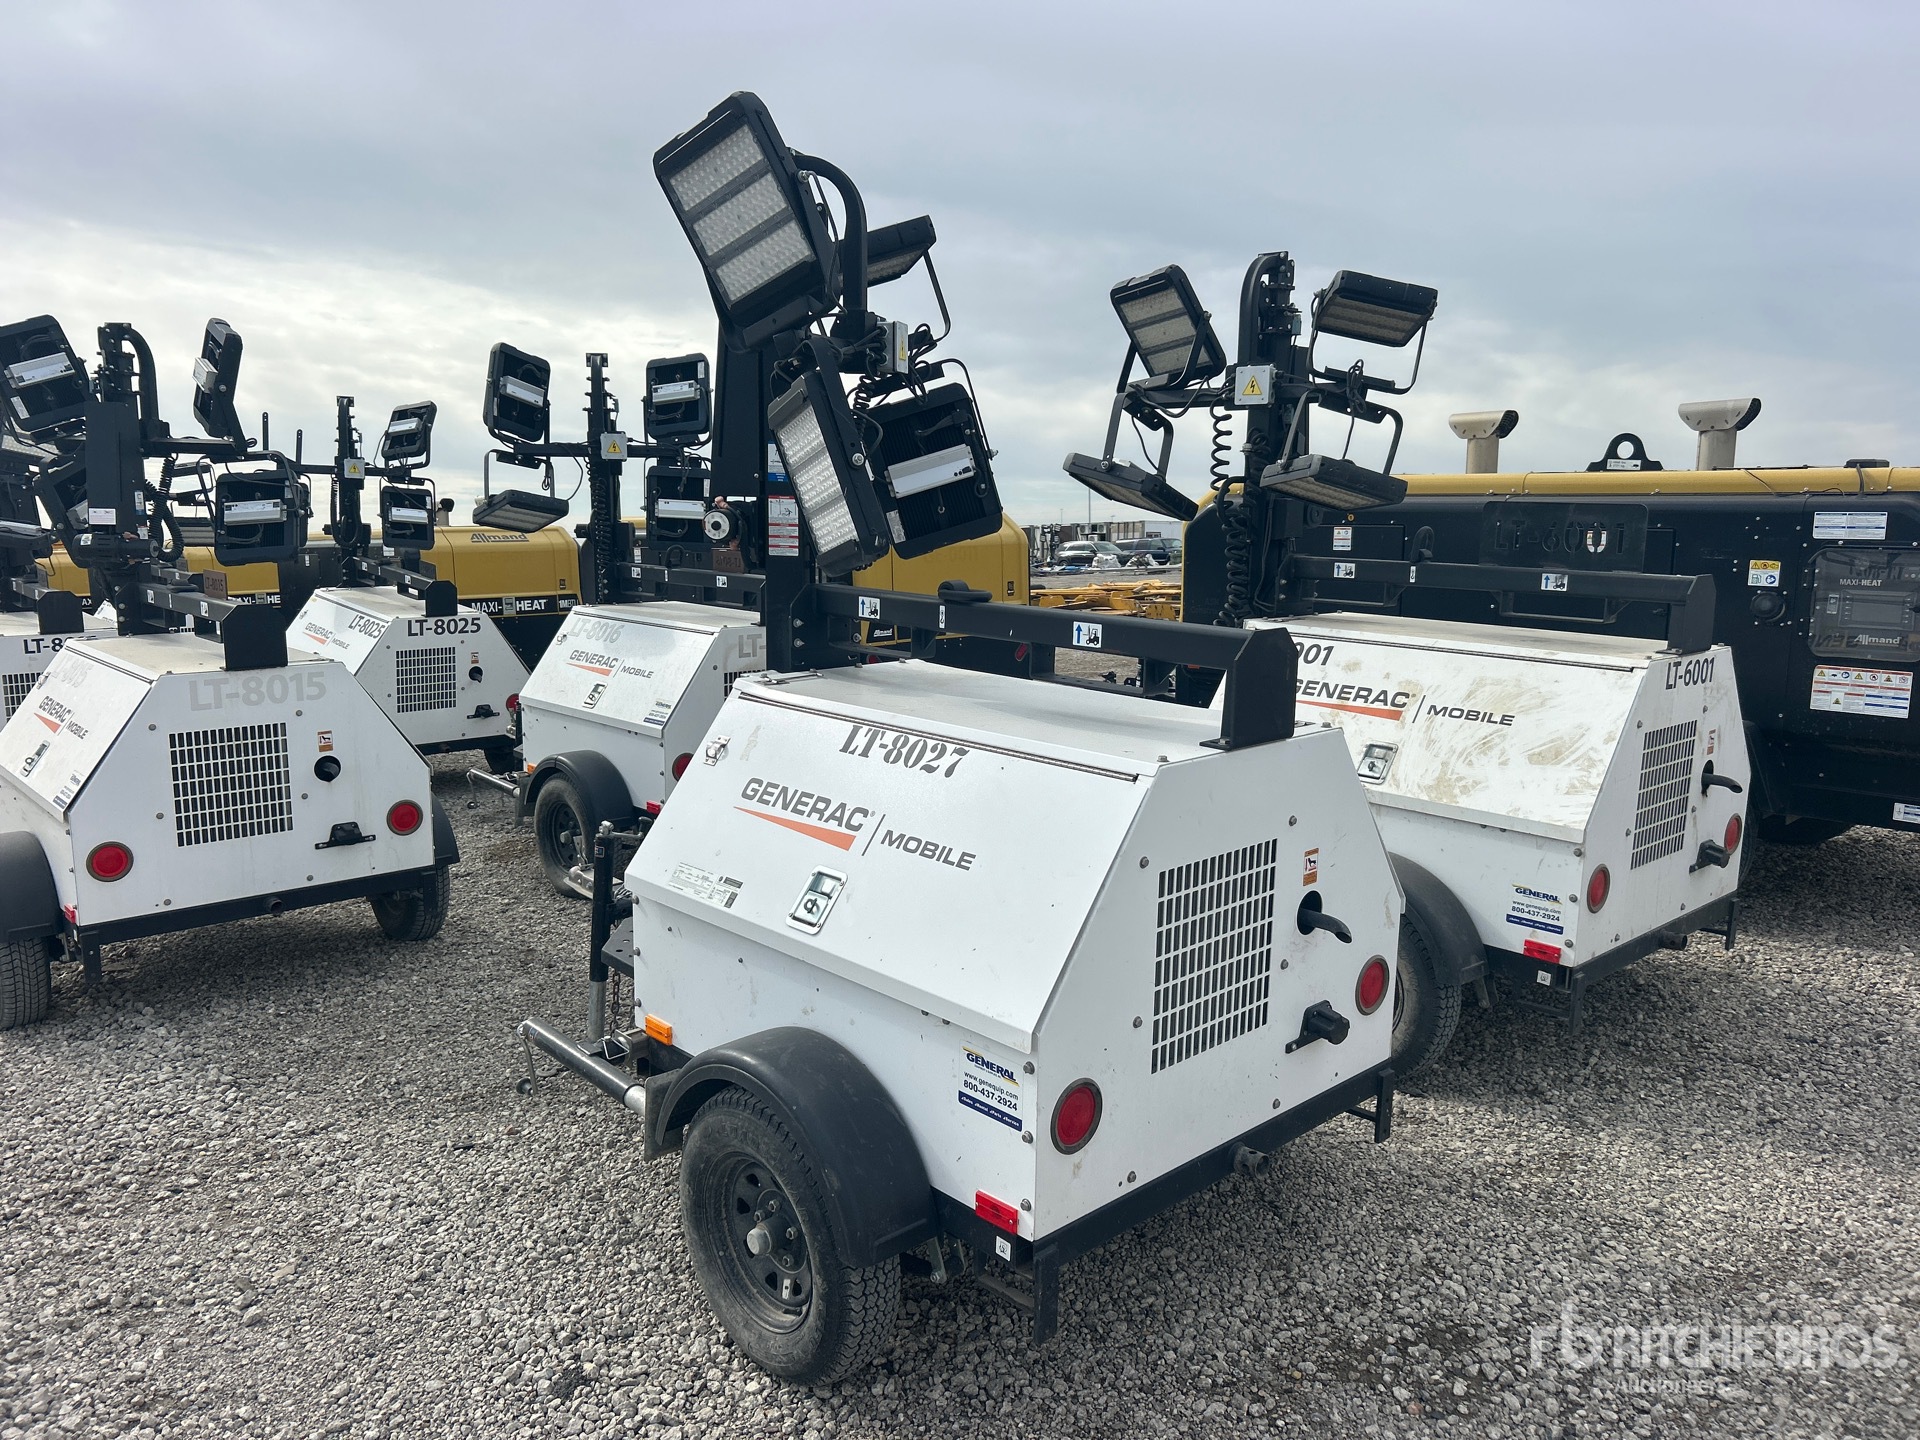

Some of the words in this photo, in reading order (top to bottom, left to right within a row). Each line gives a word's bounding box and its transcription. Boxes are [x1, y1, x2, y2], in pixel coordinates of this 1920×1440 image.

[470, 532, 529, 543] Allmand
[1494, 521, 1626, 554] LT-6001
[1839, 578, 1883, 587] MAXI-HEAT
[516, 599, 547, 611] HEAT
[304, 621, 333, 640] GENERAC
[331, 637, 351, 650] MOBILE
[348, 613, 386, 640] LT-8025
[407, 617, 482, 637] LT-8025
[569, 617, 626, 644] LT-8016
[1854, 633, 1902, 646] Allmand
[23, 636, 68, 655] LT-8
[738, 633, 767, 659] LT-
[569, 649, 620, 669] GENERAC
[620, 665, 655, 679] MOBILE
[1665, 657, 1715, 690] LT-6001
[188, 671, 328, 712] LT-8015
[38, 695, 72, 725] GENERAC
[66, 720, 90, 741] MOBILE
[1426, 704, 1516, 727] MOBILE
[838, 724, 972, 779] LT-8027
[740, 776, 871, 833] GENERAC
[880, 828, 977, 872] MOBILE
[1515, 887, 1560, 903] GENERAL
[1511, 905, 1560, 922] 800-437-2924
[966, 1052, 1017, 1082] GENERAL
[963, 1071, 1019, 1101] www.genequip.com
[963, 1079, 1018, 1112] 800-437-2924
